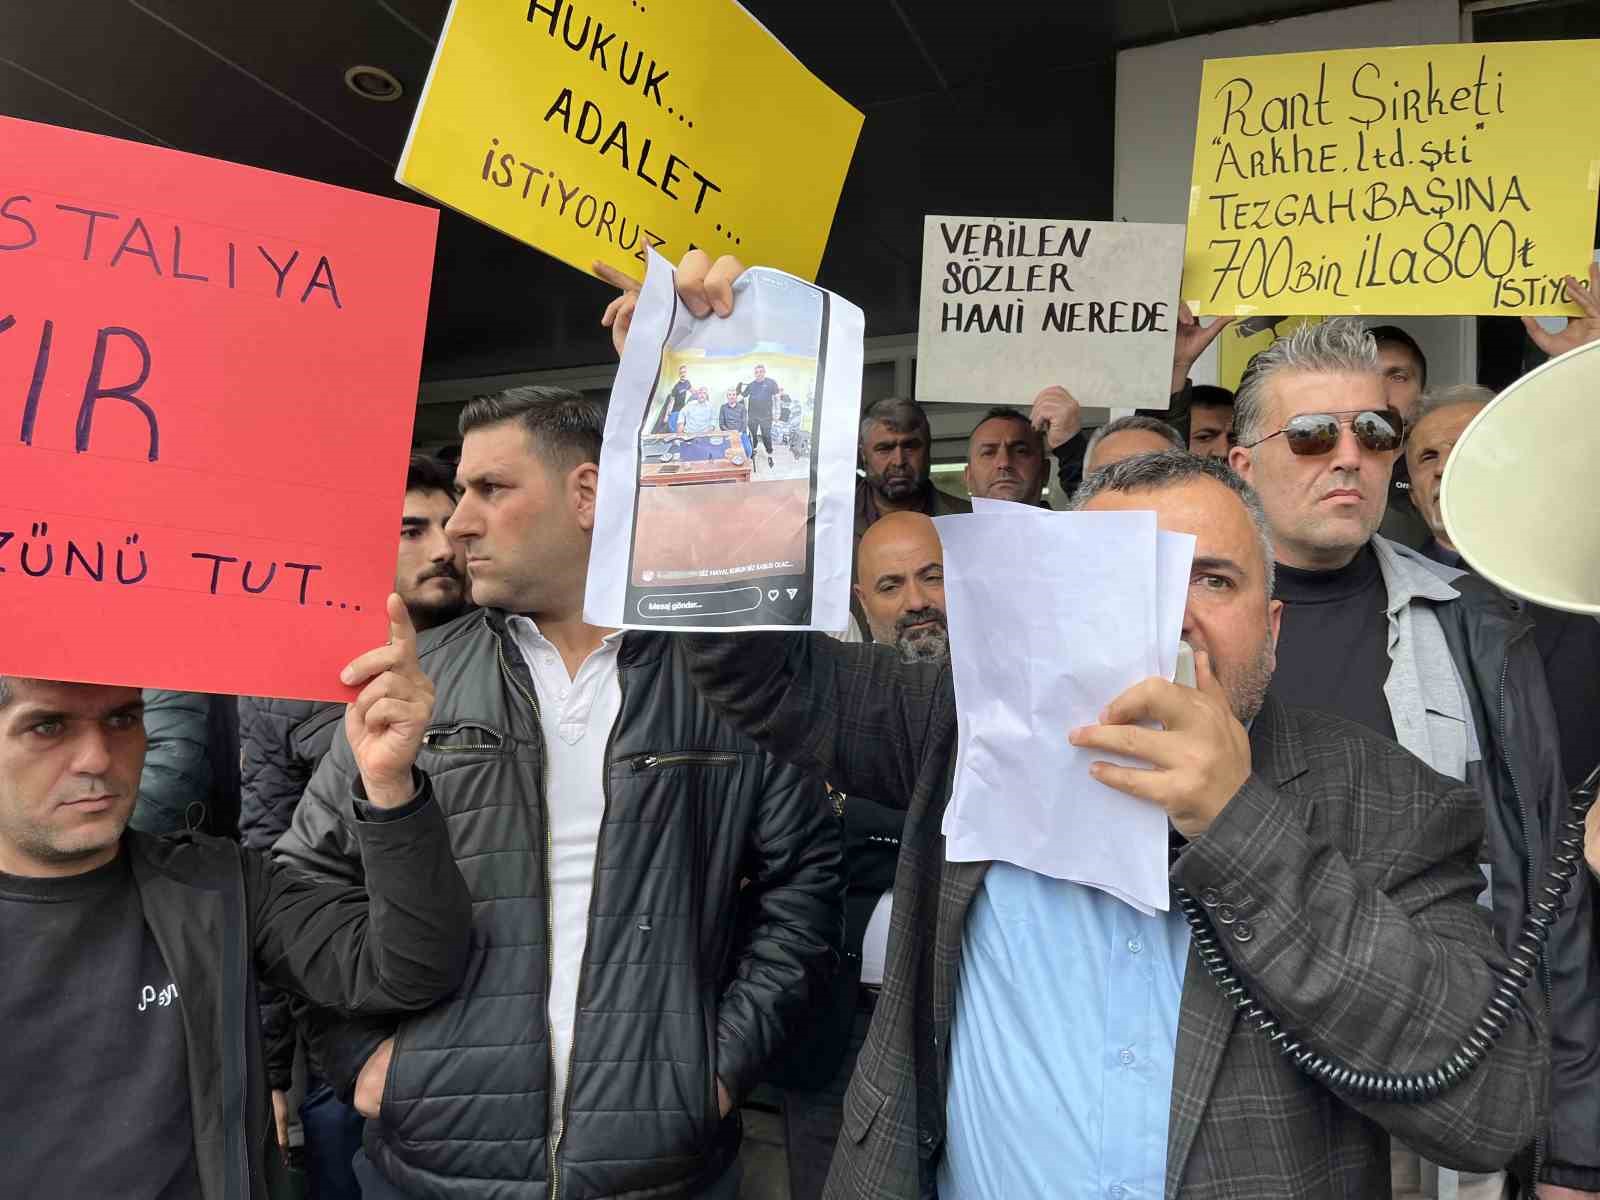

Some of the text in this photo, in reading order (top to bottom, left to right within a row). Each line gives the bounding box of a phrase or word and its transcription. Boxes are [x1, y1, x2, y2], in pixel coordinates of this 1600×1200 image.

[1214, 62, 1334, 137] Rant
[940, 221, 1092, 258] VERİLEN
[942, 258, 1075, 294] SÖZLER
[941, 298, 1169, 333] HANİ NEREDE
[191, 552, 361, 611] TUT...
